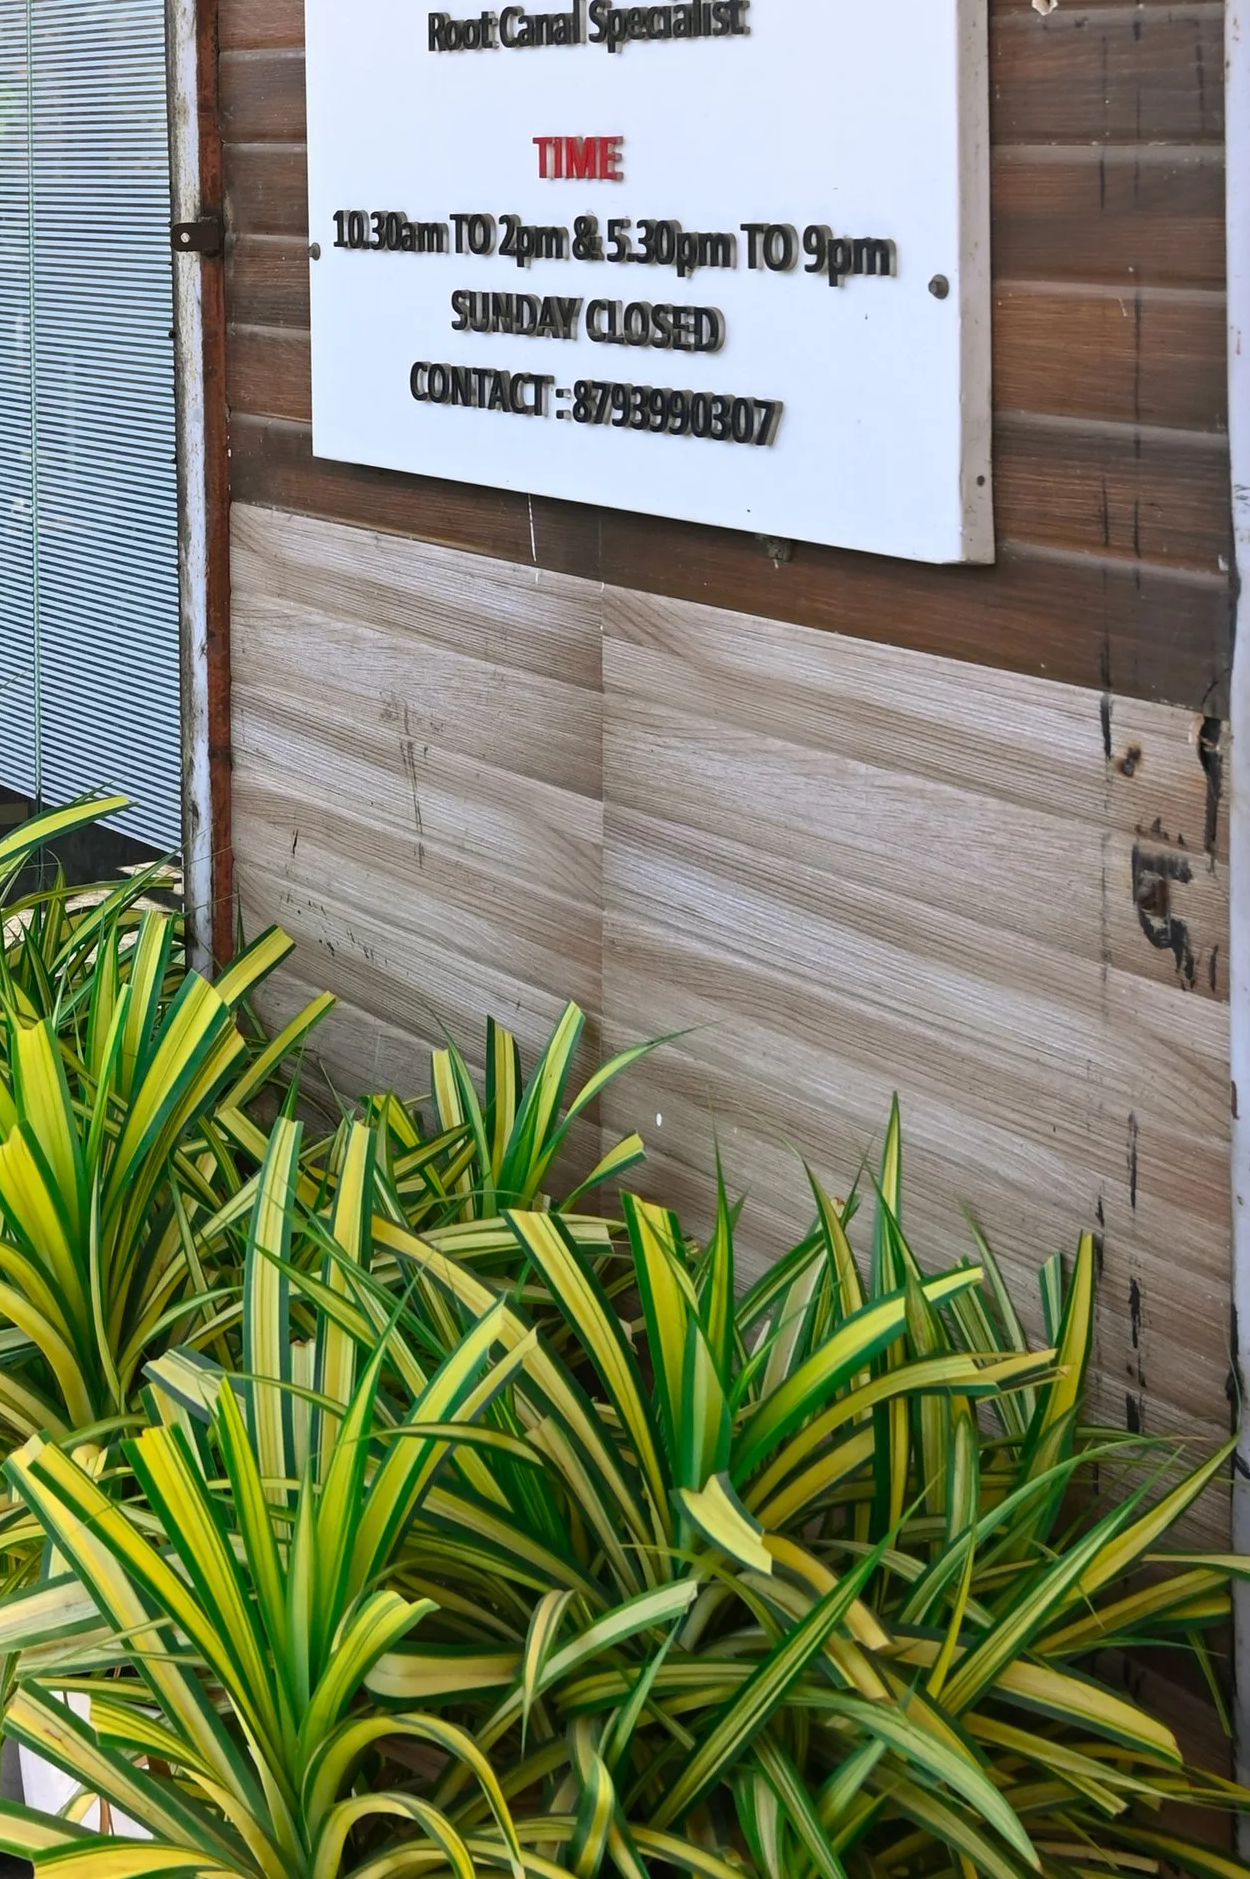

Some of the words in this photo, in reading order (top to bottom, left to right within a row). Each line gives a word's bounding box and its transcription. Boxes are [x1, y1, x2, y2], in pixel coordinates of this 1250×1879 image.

[427, 11, 499, 52] Root
[532, 135, 625, 180] TIME
[332, 210, 449, 255] 10.30am
[449, 212, 497, 256] TO
[498, 214, 569, 268] 2pm
[572, 215, 604, 261] &
[606, 218, 738, 278] 5.30pm
[740, 223, 798, 272] TO
[802, 224, 897, 287] 9pm
[450, 289, 583, 340] SUNDAY
[585, 297, 727, 354] CLOSED
[573, 379, 784, 447] 8793990307
